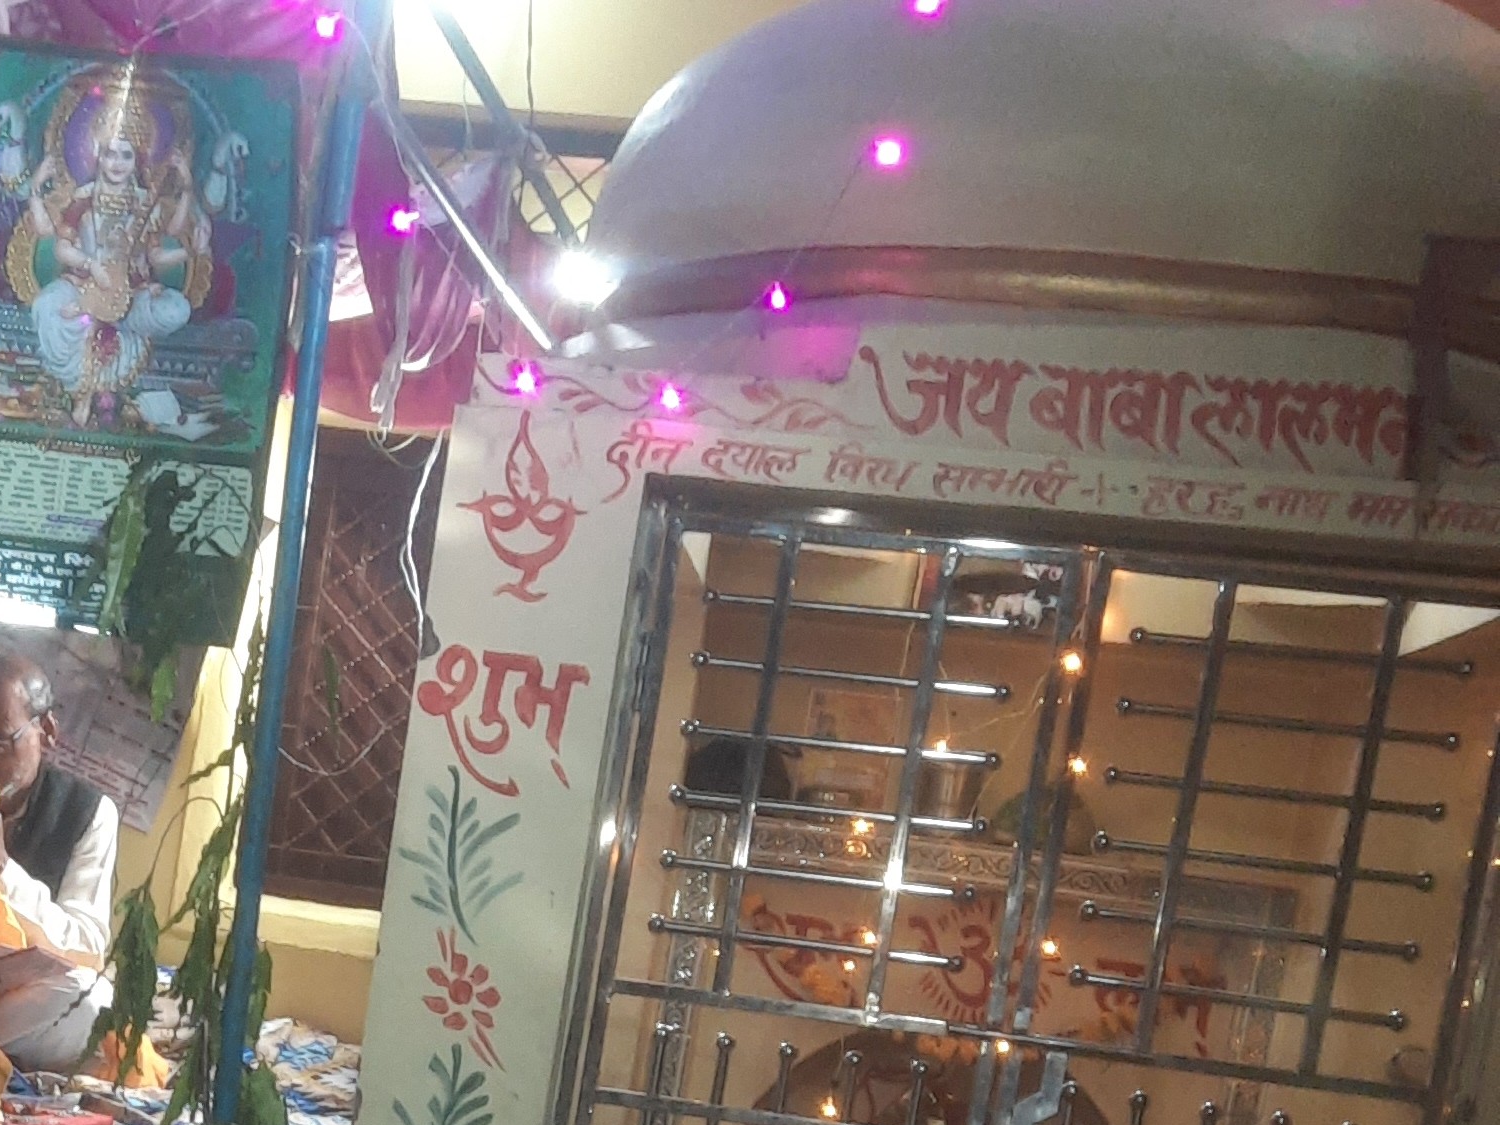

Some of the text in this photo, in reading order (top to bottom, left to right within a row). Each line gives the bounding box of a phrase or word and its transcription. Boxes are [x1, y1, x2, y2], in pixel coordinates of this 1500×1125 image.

[859, 344, 1034, 447] जय
[1029, 361, 1205, 456] बाबा
[601, 417, 693, 504] दीन
[701, 437, 811, 482] दयाल
[417, 644, 591, 797] शुभ
